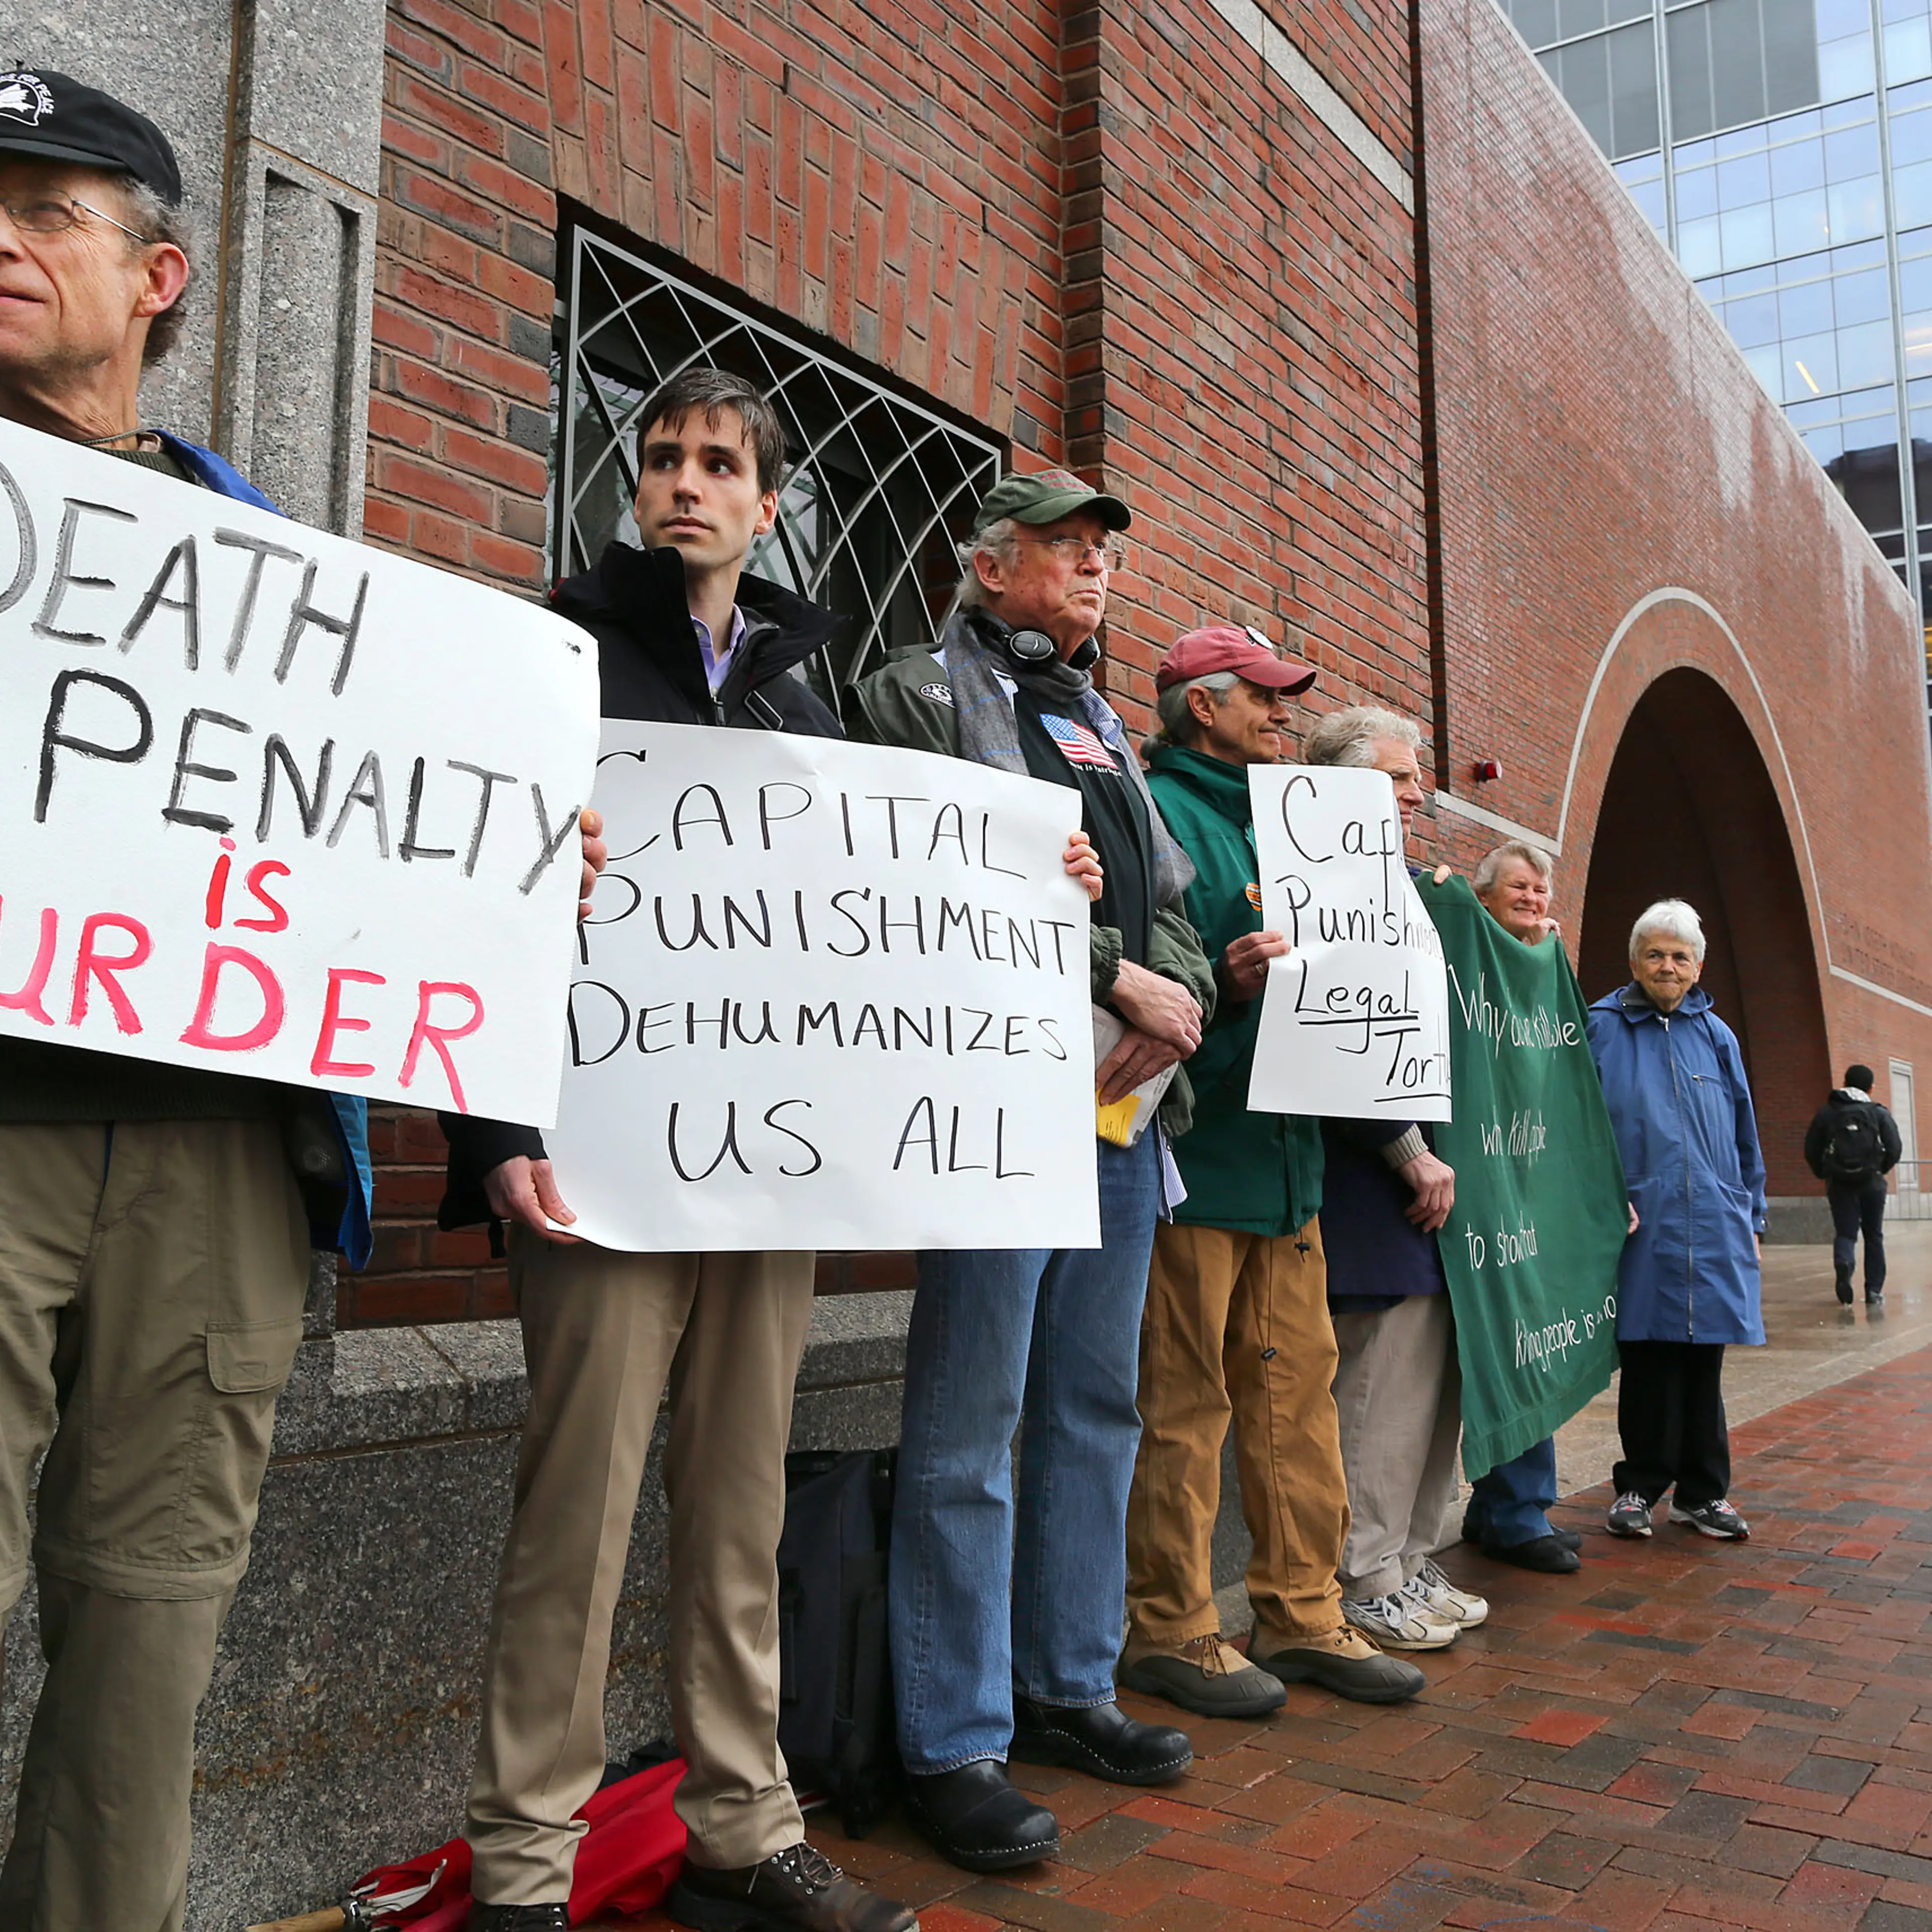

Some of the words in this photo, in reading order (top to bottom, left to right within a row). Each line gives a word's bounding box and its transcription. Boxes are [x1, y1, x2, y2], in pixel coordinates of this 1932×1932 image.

[35, 83, 54, 115] PEACE
[33, 668, 582, 896] PENALTY
[597, 750, 1027, 880] CAPITAL
[1281, 774, 1395, 913] Cap
[577, 873, 1076, 976] PUNISHMENT
[0, 894, 485, 1114] URDER
[567, 981, 1067, 1067] DEHUMANIZES
[1447, 963, 1508, 1060] Why
[668, 1098, 822, 1182] US
[893, 1096, 1035, 1179] ALL
[1465, 1222, 1485, 1272] to
